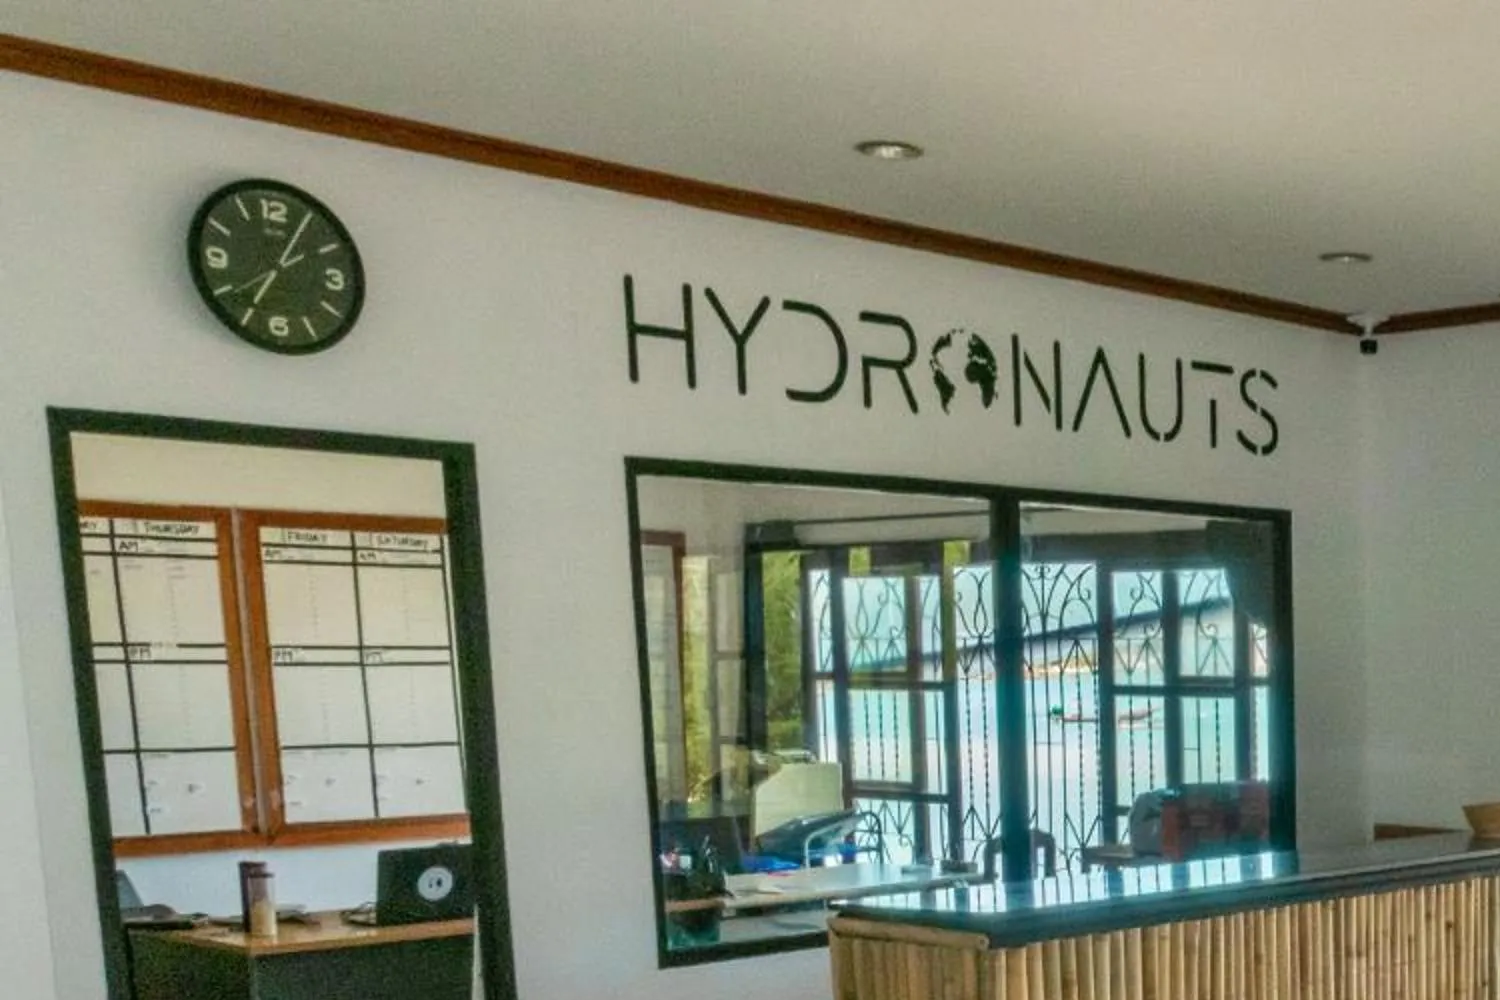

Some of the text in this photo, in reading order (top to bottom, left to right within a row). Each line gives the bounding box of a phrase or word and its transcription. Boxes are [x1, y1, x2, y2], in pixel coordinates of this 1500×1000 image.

[260, 198, 288, 222] 12
[205, 246, 229, 269] 9
[325, 268, 345, 291] 3
[268, 316, 289, 336] 6
[119, 540, 139, 551] AM
